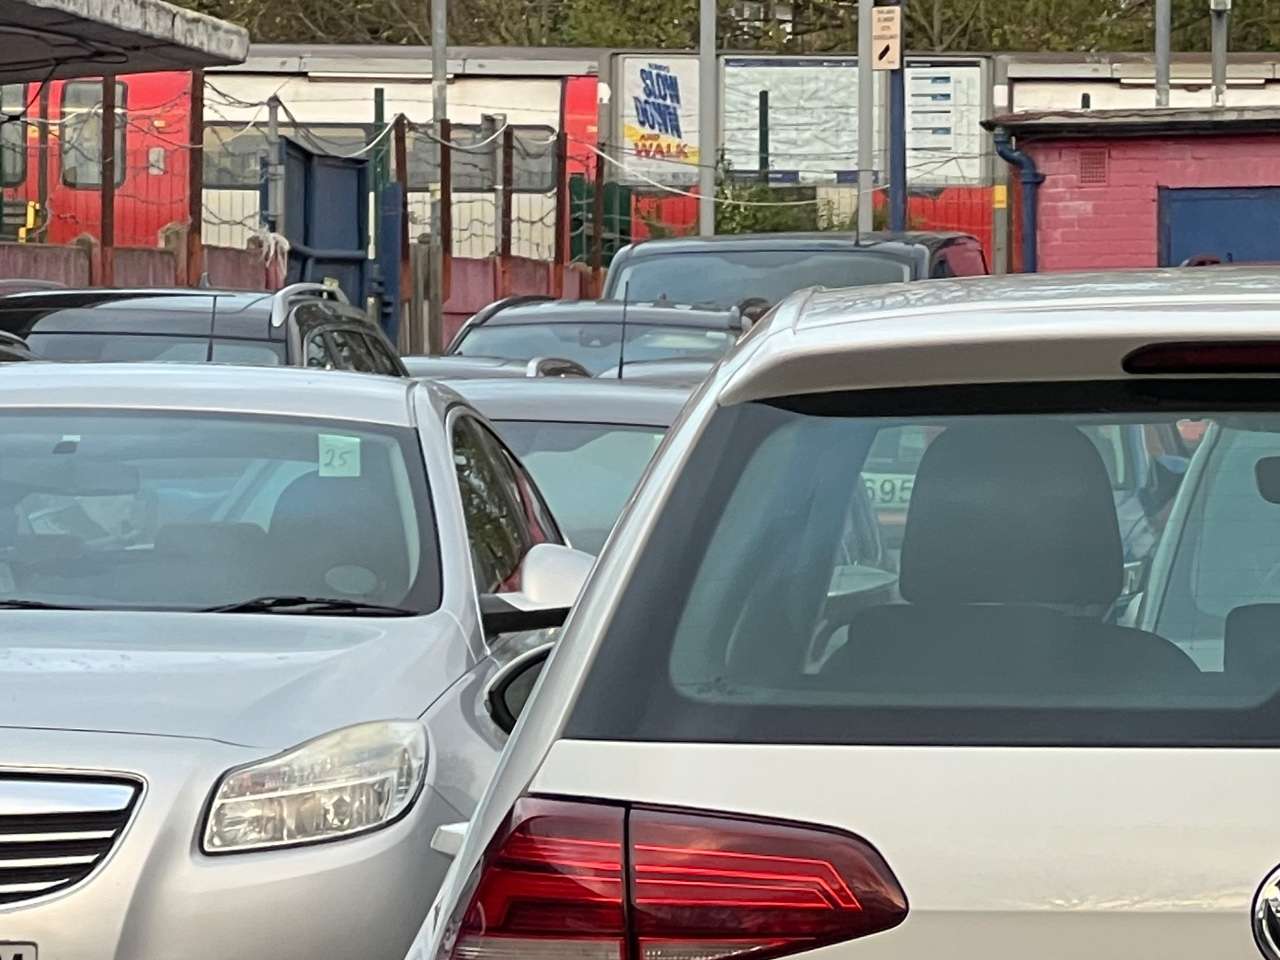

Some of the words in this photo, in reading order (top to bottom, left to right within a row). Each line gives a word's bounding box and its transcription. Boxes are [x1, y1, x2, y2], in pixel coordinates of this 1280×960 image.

[640, 68, 680, 105] SLOW
[633, 95, 682, 139] DOWN
[633, 142, 688, 158] WALK
[323, 448, 353, 468] 25
